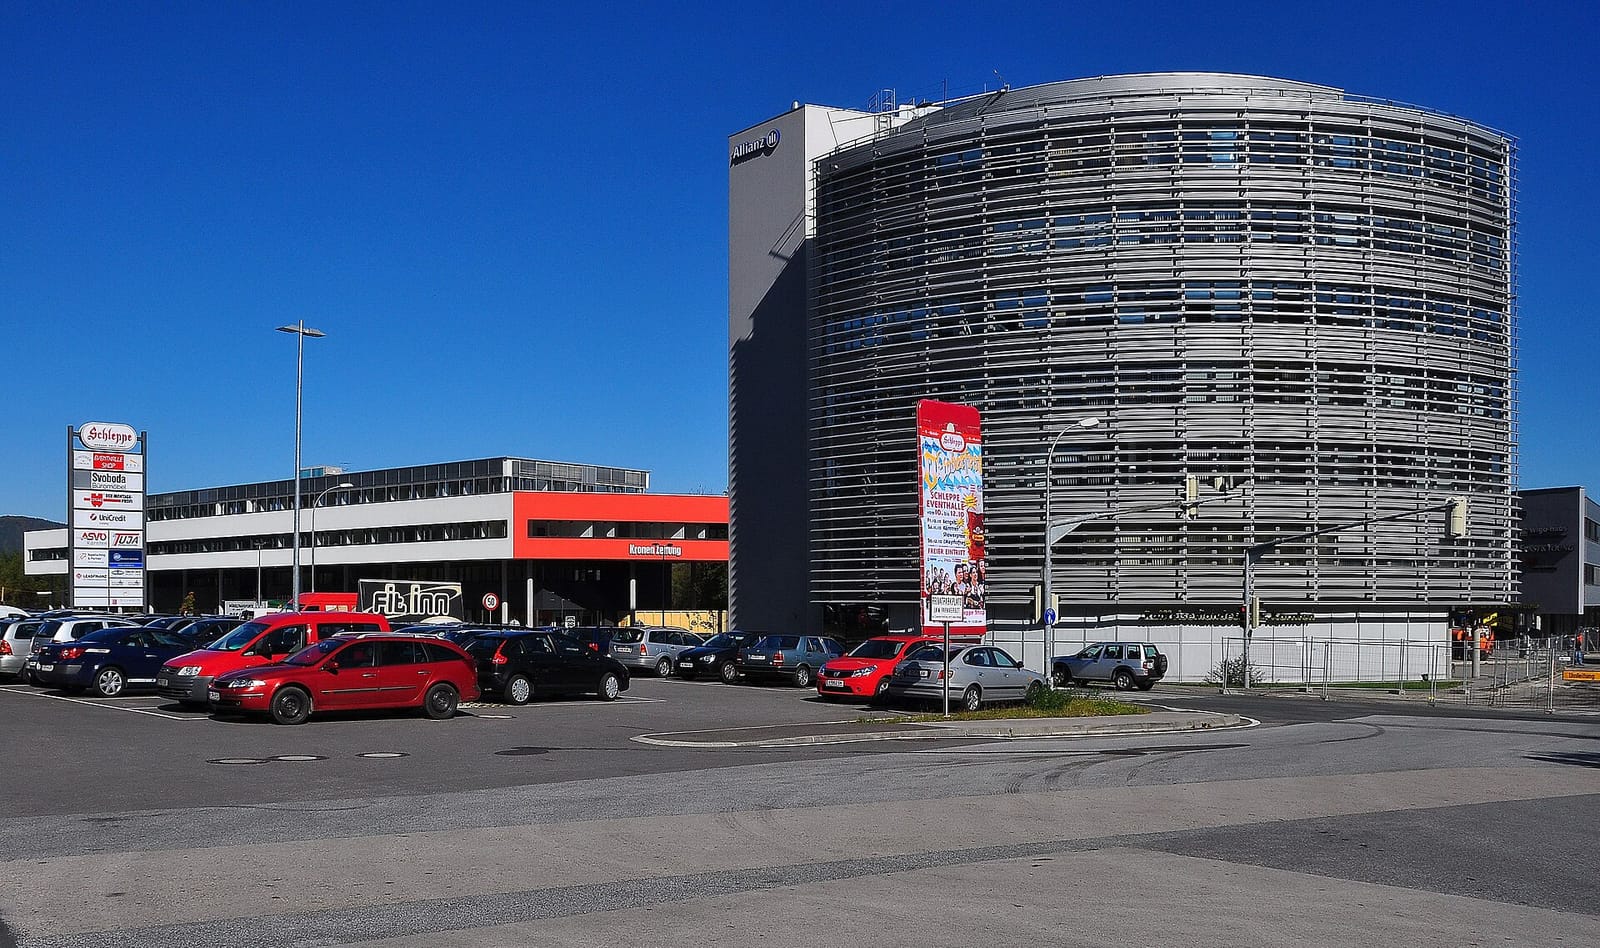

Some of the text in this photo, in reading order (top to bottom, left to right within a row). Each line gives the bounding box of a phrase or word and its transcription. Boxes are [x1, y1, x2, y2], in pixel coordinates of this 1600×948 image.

[732, 138, 765, 159] Allianz
[88, 427, 132, 444] Schleppe
[92, 472, 126, 483] Svoboda
[92, 482, 126, 490] Büromöbel
[931, 491, 960, 502] SCHLEPPE
[926, 500, 965, 510] EVENTHALLE
[98, 513, 127, 522] UniCredit
[113, 533, 140, 546] TUJA
[629, 544, 682, 556] Kronen Zeitung
[927, 547, 966, 556] FREIER EINTRITT
[487, 597, 495, 606] 50
